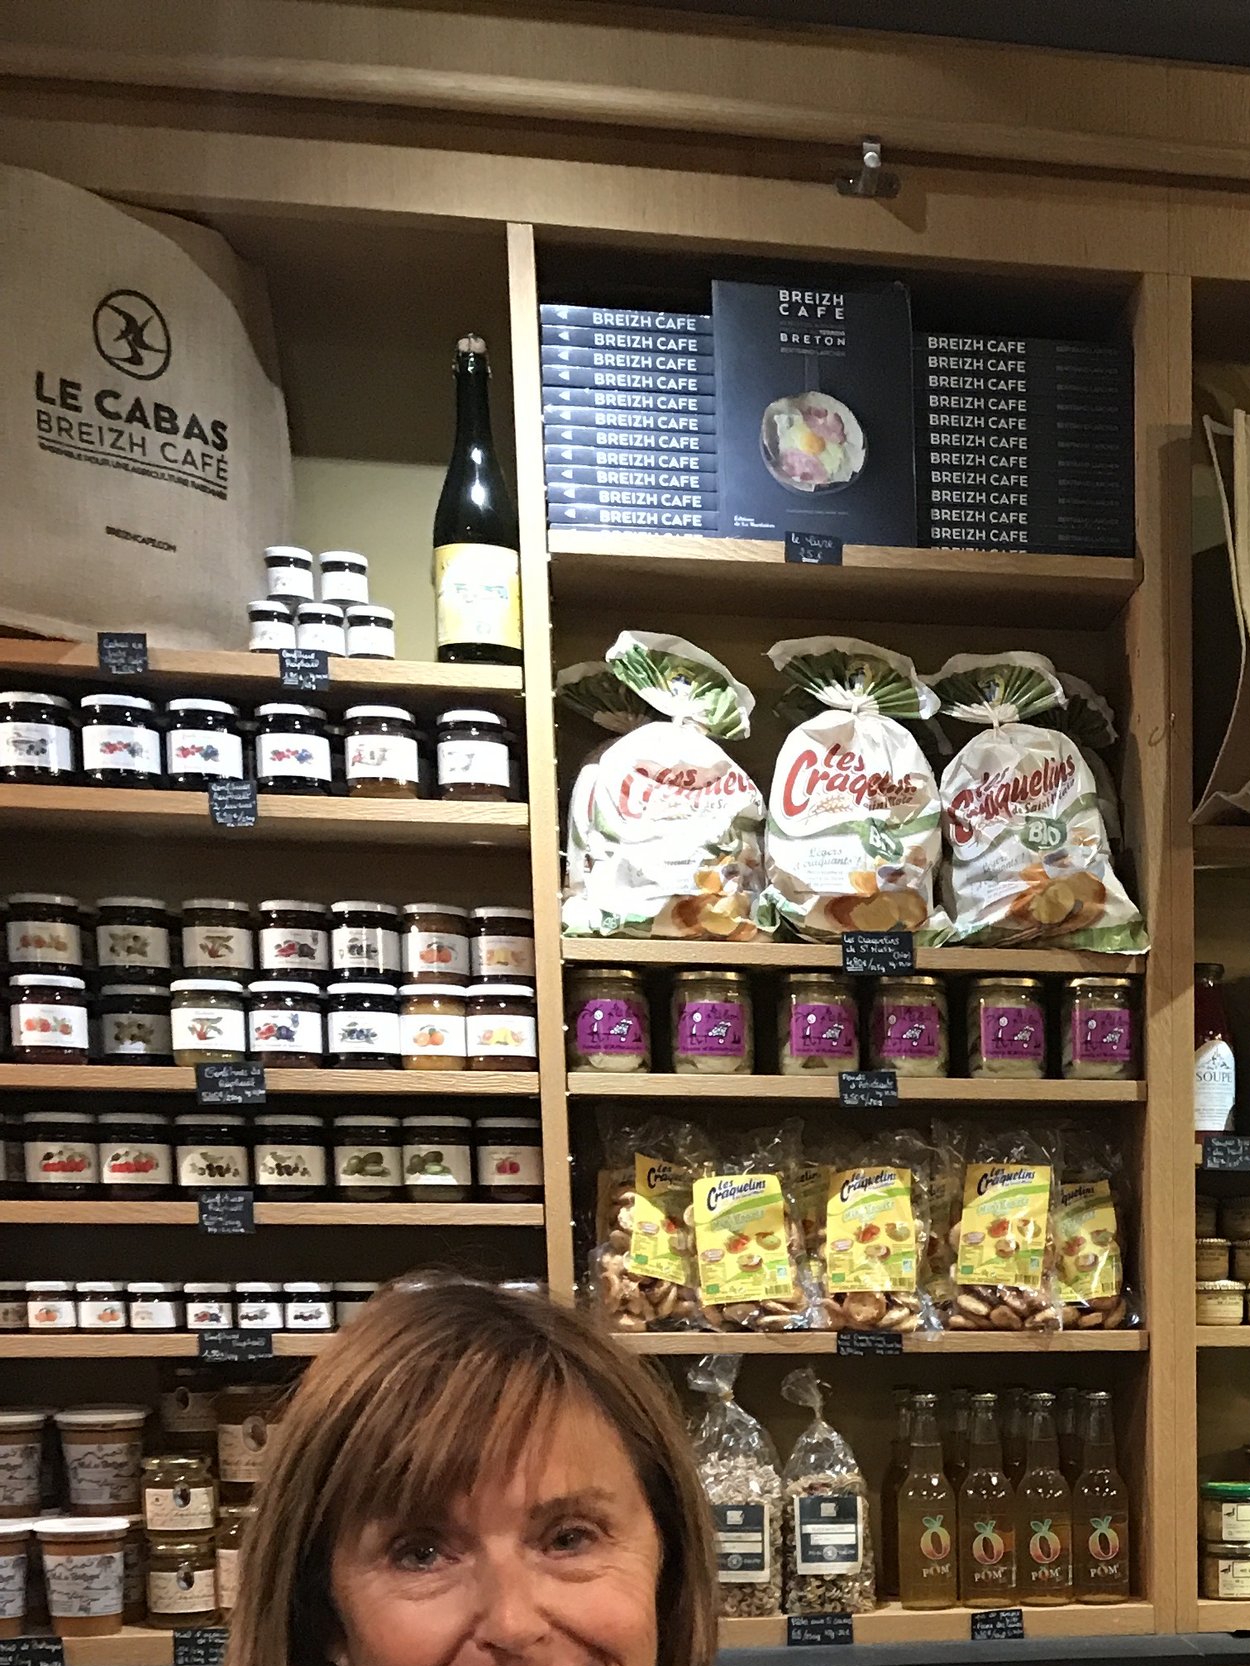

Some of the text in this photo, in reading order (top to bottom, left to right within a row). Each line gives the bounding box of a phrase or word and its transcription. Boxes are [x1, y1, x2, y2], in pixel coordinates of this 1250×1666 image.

[779, 290, 844, 306] BREIZH
[779, 303, 845, 320] CAFE
[593, 312, 697, 330] BREIZH CAFE
[594, 333, 697, 351] BREIZH CAFE
[780, 332, 846, 346] BRETON
[928, 337, 1026, 354] BREIZH CAFE
[594, 353, 697, 371] BREIZH CAFE
[928, 356, 1026, 373] BREIZH CAFE
[594, 373, 697, 391] BREIZH CAFE
[928, 375, 1026, 392] BREIZH CAFE
[595, 393, 698, 411] BREIZH CAFE
[929, 395, 1027, 411] BREIZH CAFE
[36, 371, 228, 452] LE CABAS
[595, 413, 698, 430] BREIZH CAFE
[929, 414, 1027, 430] BREIZH CAFE
[36, 409, 228, 482] BREIZH CAFÉ
[596, 432, 699, 450] BREIZH CAFE
[930, 433, 1027, 449] BREIZH CAFE
[596, 452, 699, 469] BREIZH CAFE
[931, 452, 1028, 468] BREIZH CAFE
[596, 471, 700, 488] BREIZH CAFE
[931, 471, 1028, 487] BREIZH CAFE
[599, 490, 702, 508] BREIZH CAFE
[931, 490, 1028, 506] BREIZH CAFE
[600, 510, 702, 526] BREIZH CAFE
[931, 509, 1028, 524] BREIZH CAFE
[931, 527, 1028, 543] BREIZH CAFE
[1028, 820, 1061, 846] BIO
[1196, 1071, 1232, 1082] SOUPE
[977, 1170, 1036, 1195] Craquelins
[707, 1178, 766, 1211] Craquelins
